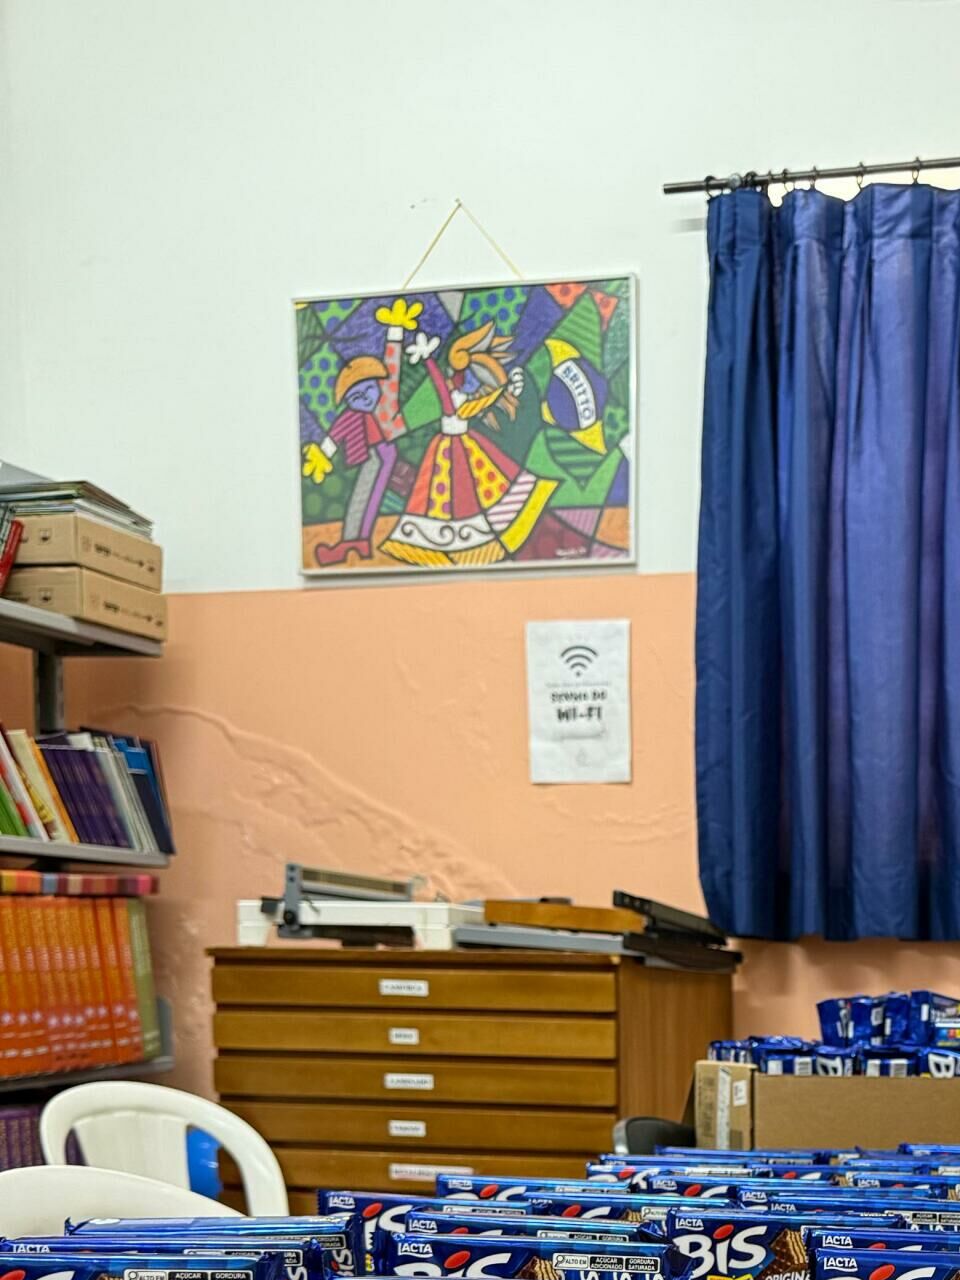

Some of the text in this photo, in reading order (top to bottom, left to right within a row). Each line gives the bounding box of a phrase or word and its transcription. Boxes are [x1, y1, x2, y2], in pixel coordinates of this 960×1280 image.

[562, 364, 594, 422] BRITTO
[409, 1218, 438, 1232] LACTA
[676, 1217, 704, 1230] LACTA
[822, 1234, 852, 1248] LACTA
[398, 1242, 434, 1257] LACTA
[673, 1224, 769, 1280] BiS
[824, 1257, 858, 1271] LACTA
